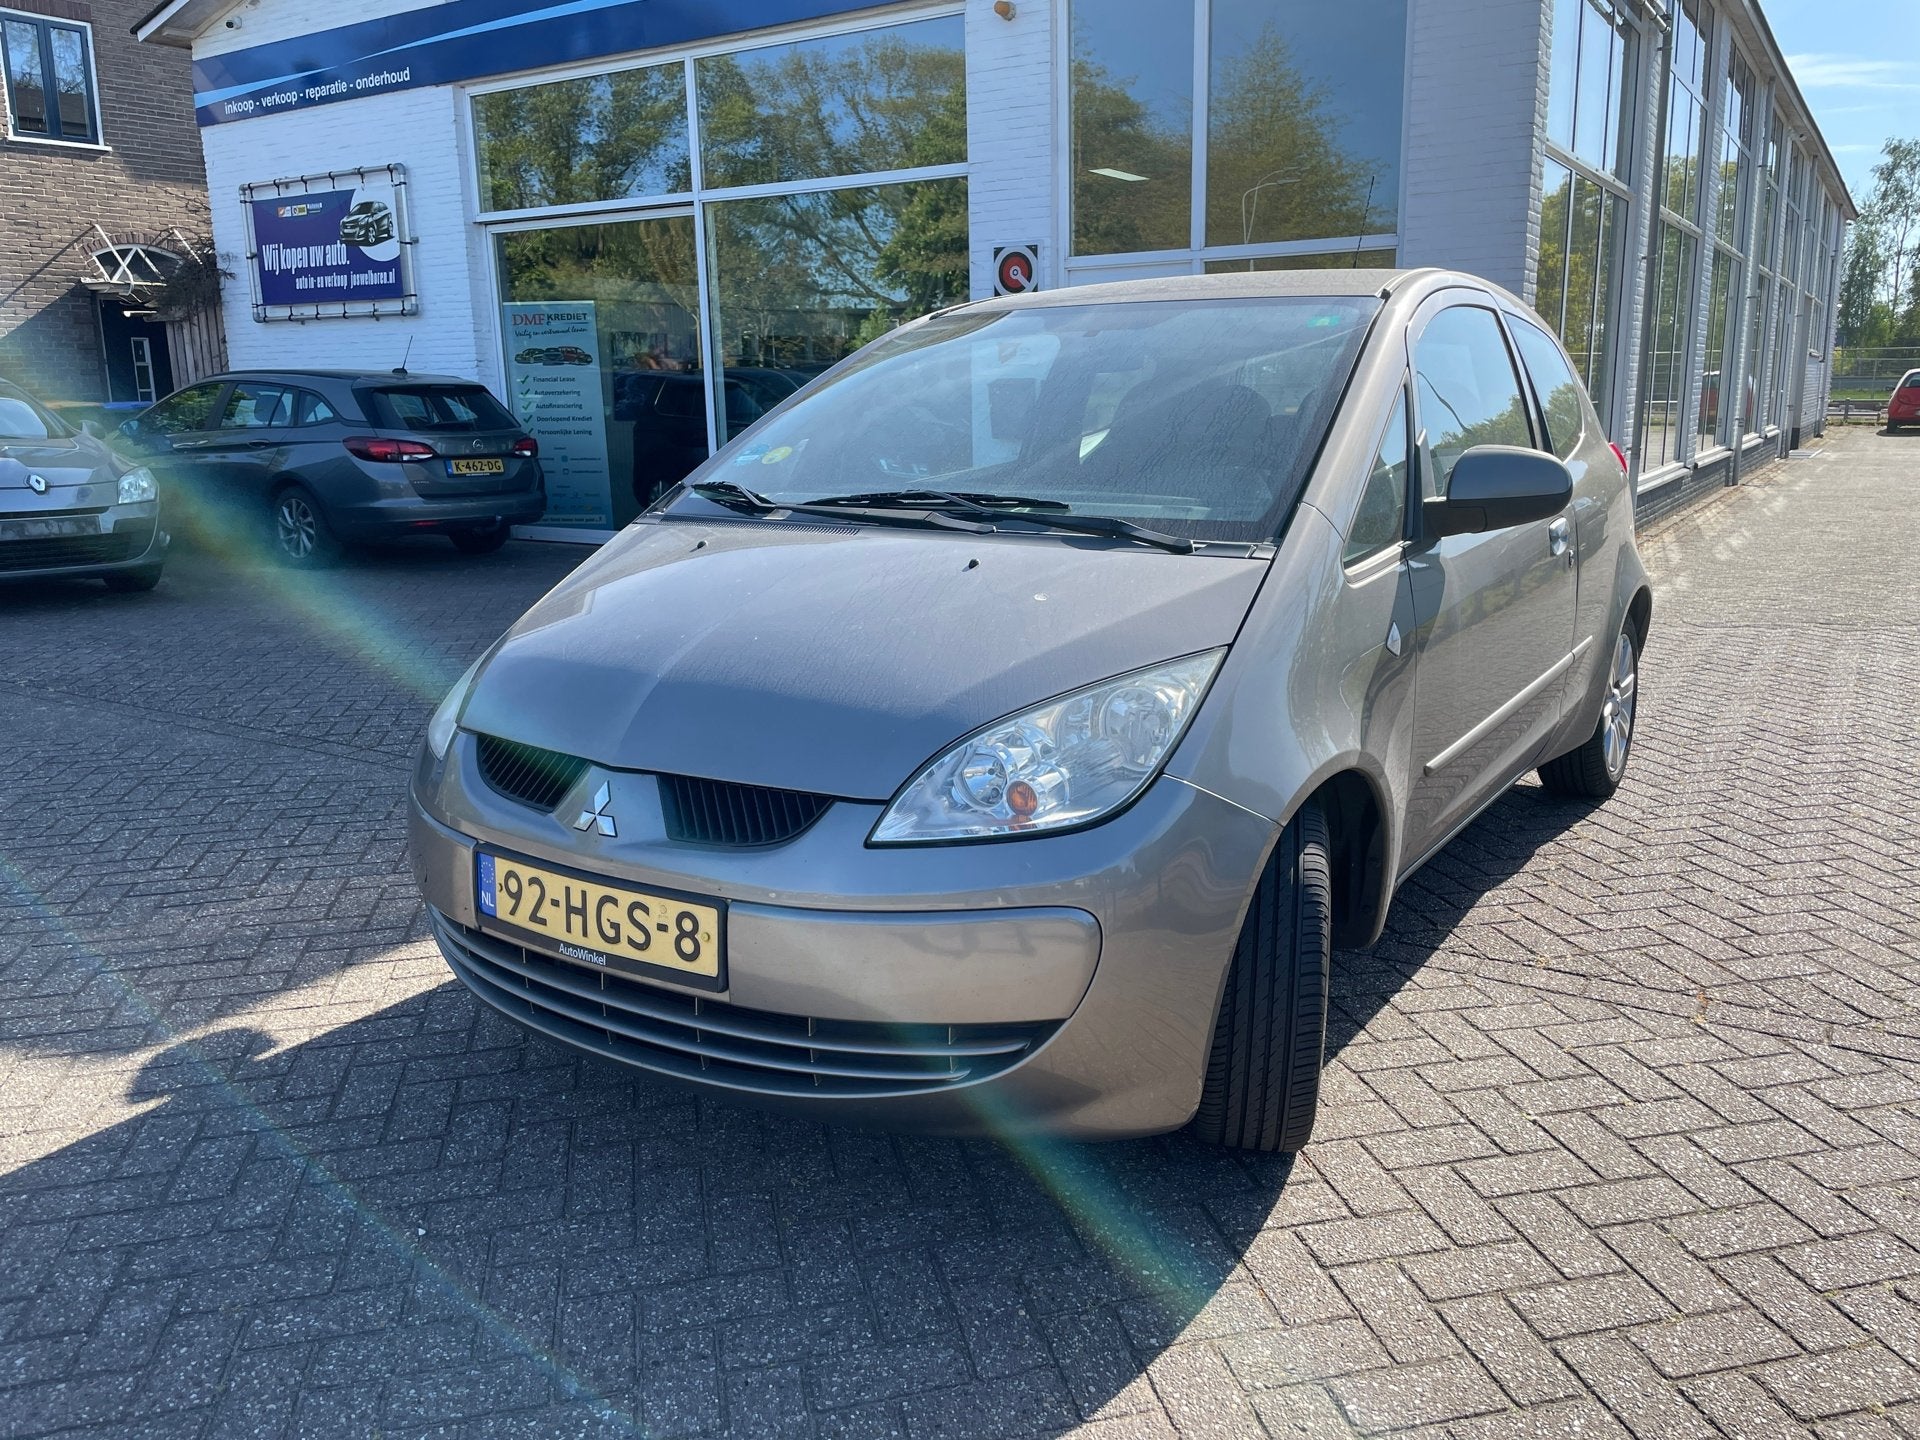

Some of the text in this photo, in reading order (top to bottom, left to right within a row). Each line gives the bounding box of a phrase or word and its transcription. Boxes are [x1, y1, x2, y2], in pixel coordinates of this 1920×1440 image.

[225, 99, 254, 114] inkoop
[261, 91, 298, 107] verkoop
[305, 79, 347, 101] reparatie
[356, 67, 410, 90] onderhoud
[262, 240, 350, 275] Wij kopen uw auto.
[324, 272, 348, 290] verkoop
[546, 313, 588, 321] KREDIET
[534, 389, 581, 397] Autoverzekering
[535, 402, 583, 410] Autofinanciering
[536, 415, 571, 423] Doorlopend
[537, 429, 573, 437] Persoonlijke
[454, 460, 501, 473] K-462-DG
[481, 891, 495, 908] NL
[503, 869, 701, 962] 92-HGS-8
[559, 943, 606, 966] AutoWinkel
